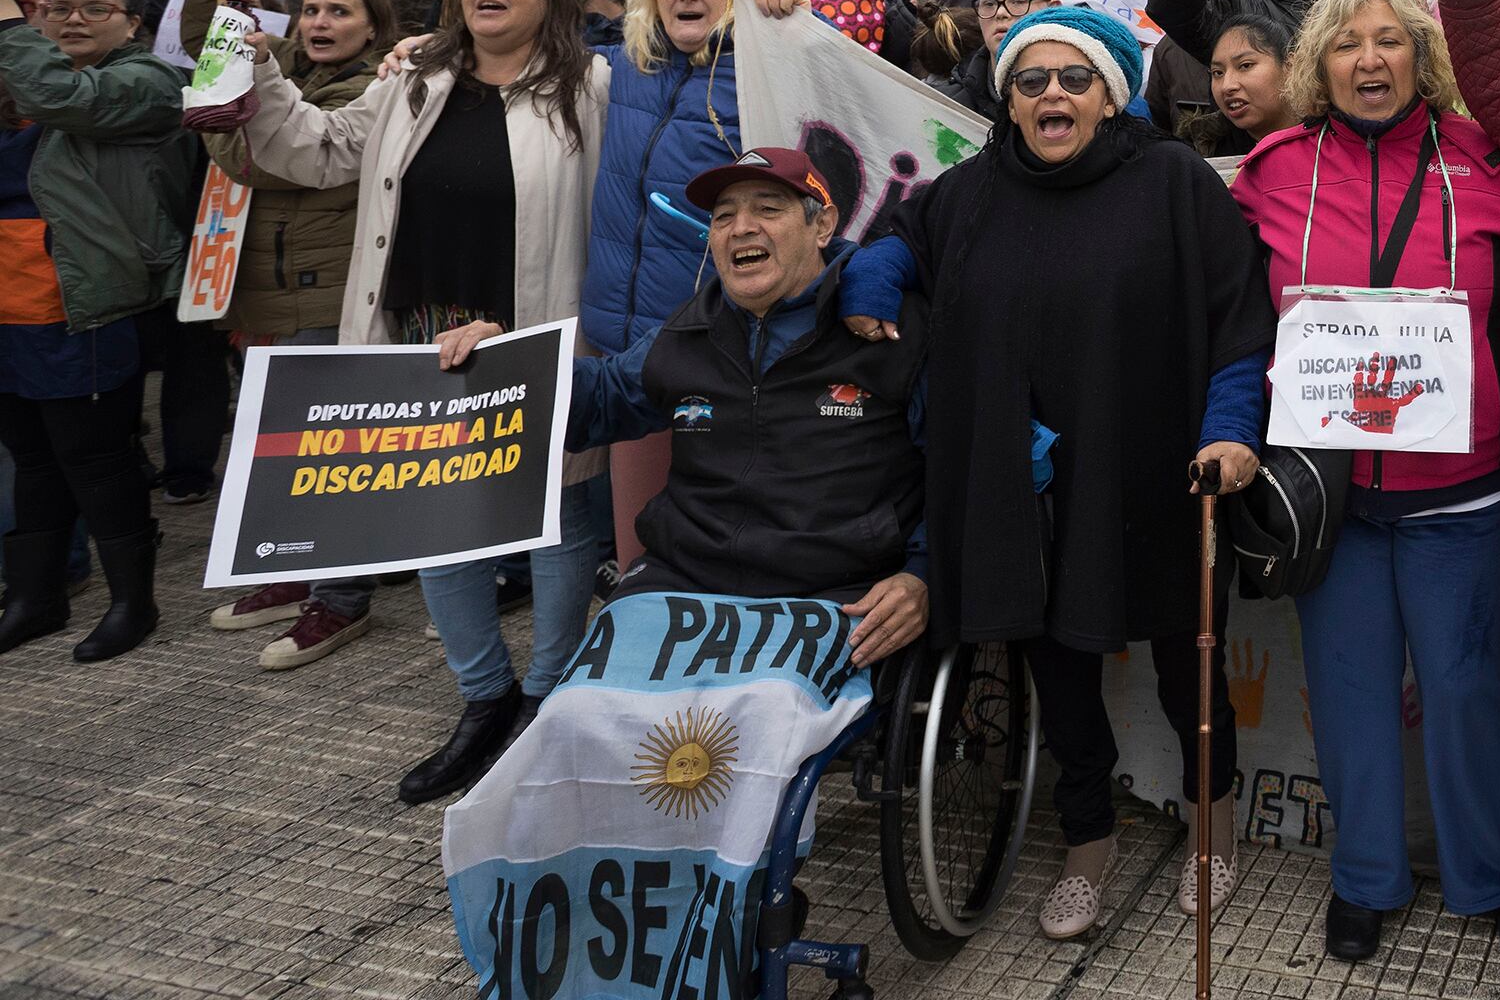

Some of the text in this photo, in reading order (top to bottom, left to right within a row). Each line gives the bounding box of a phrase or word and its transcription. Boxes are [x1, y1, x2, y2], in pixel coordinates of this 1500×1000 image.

[1298, 353, 1423, 375] DISCAPACIDAD
[306, 383, 527, 422] DIPUTADAS Y DIPUTADOS
[1301, 377, 1445, 401] EN EMERGENCIA
[297, 407, 525, 457] NO VETEN A LA
[290, 443, 522, 497] DISCAPACIDAD
[587, 858, 671, 989] SE
